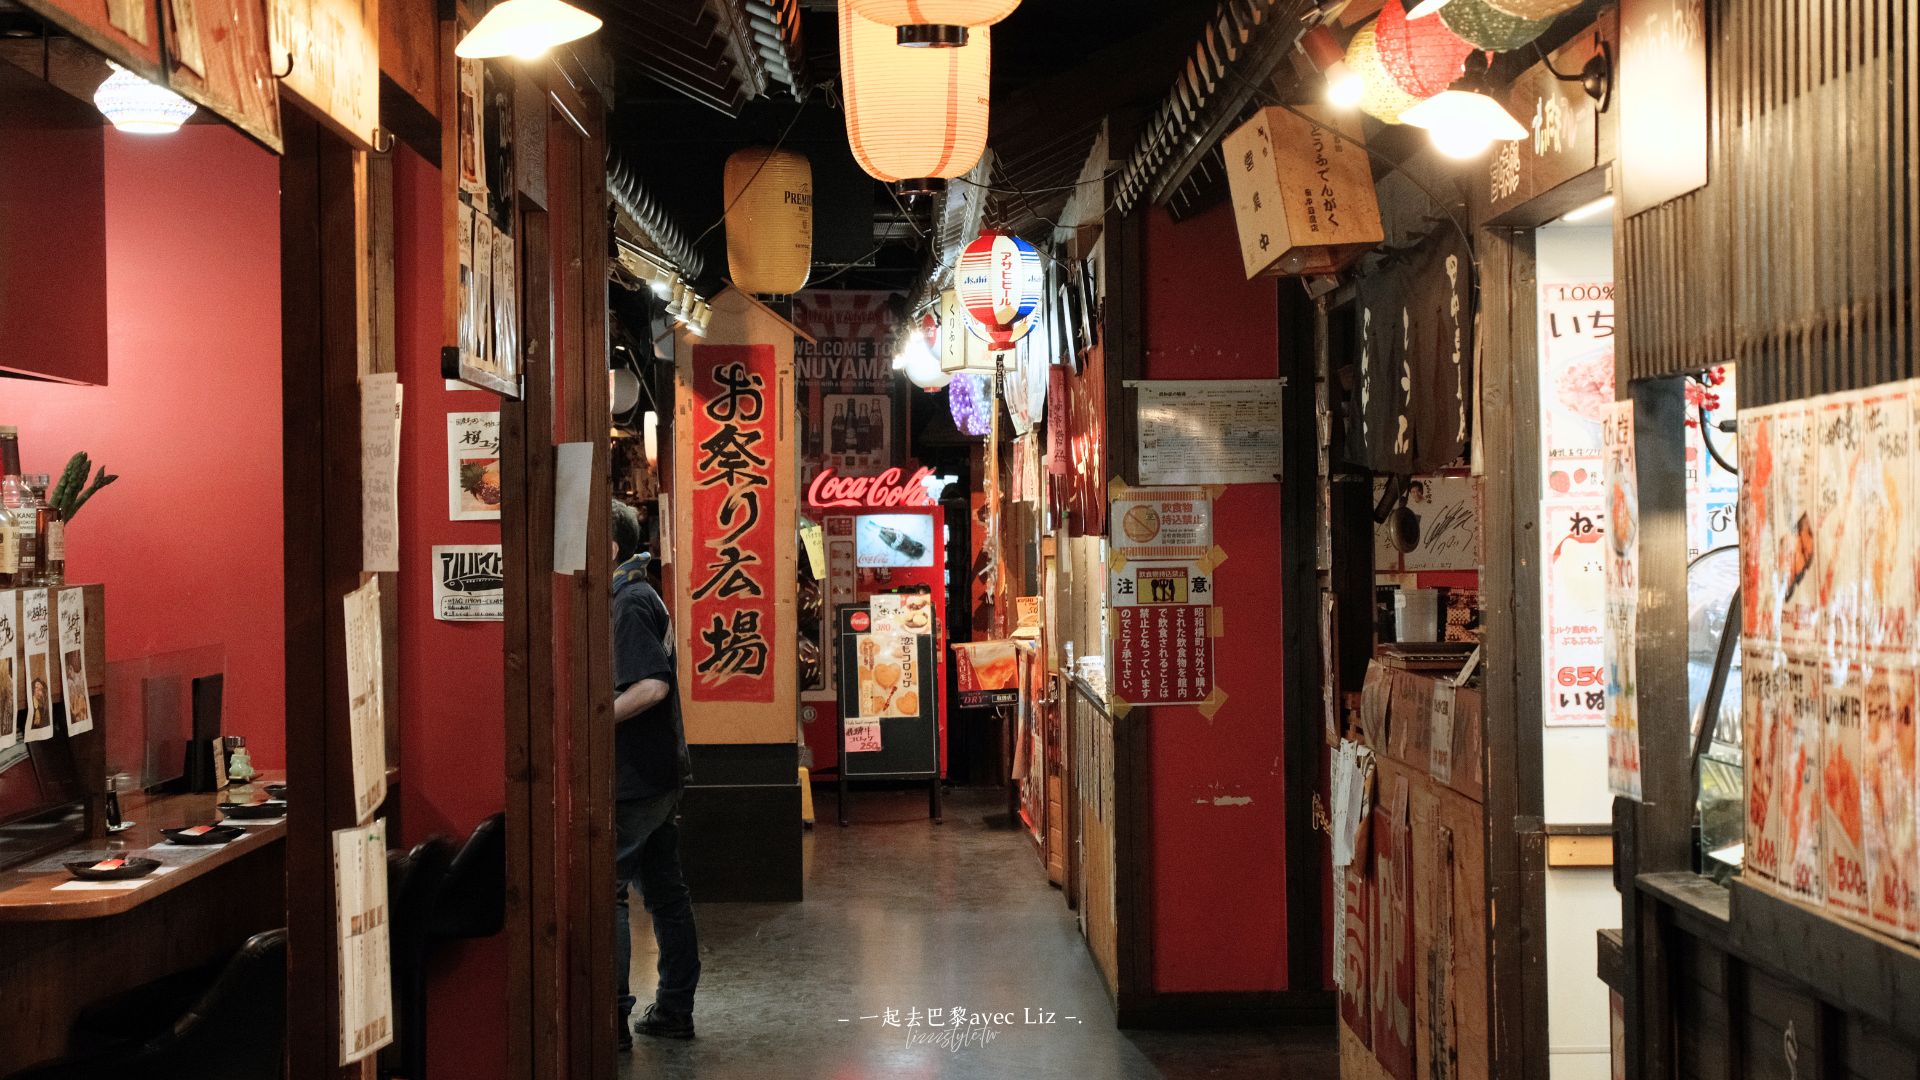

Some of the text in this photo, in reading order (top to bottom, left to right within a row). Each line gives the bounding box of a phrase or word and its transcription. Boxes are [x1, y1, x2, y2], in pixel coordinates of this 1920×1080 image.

[1000, 251, 1012, 306] アサヒビール
[796, 357, 894, 380] NUYAMA
[808, 466, 936, 508] Coca-Cola
[1161, 503, 1193, 513] 飲食物
[692, 363, 769, 677] お祭り広場
[1161, 514, 1201, 525] 持込禁止
[1117, 576, 1208, 595] 注 意
[1139, 608, 1151, 699] 禁止となっています
[1158, 608, 1169, 698] で飲食されることは
[1176, 608, 1187, 698] された飲食物を館内
[1194, 607, 1206, 698] 昭和横町以外で購入
